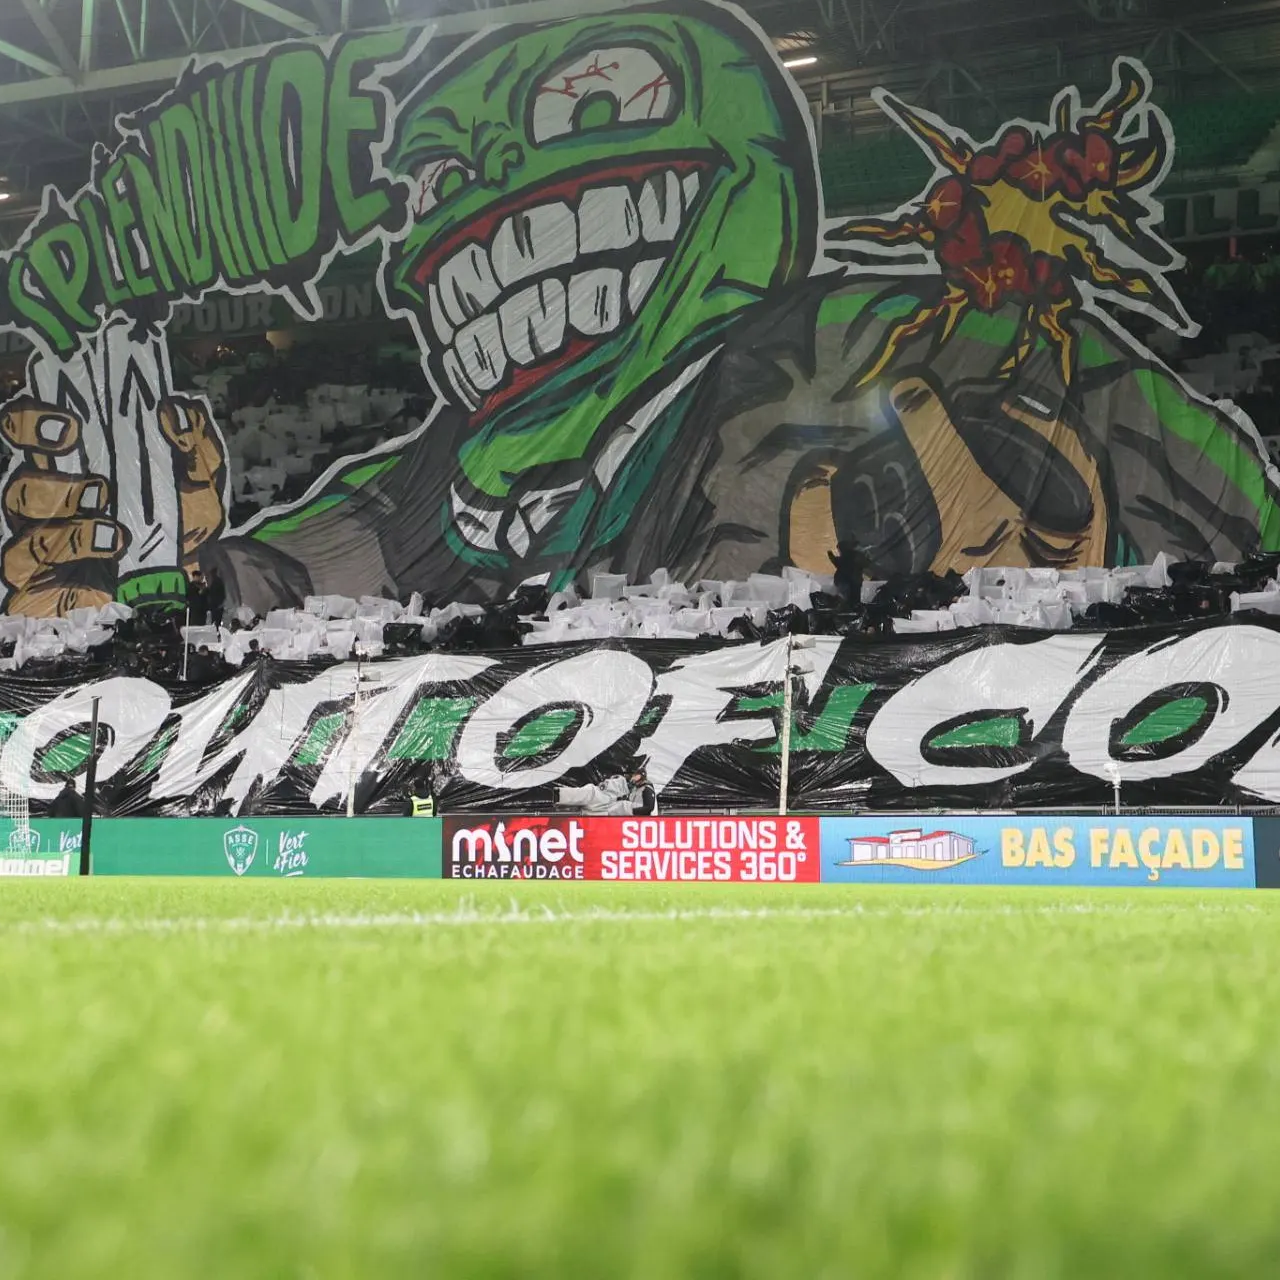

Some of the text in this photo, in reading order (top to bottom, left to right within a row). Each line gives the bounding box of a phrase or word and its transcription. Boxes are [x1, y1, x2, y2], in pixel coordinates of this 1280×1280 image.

[297, 282, 374, 324] ON
[227, 833, 255, 845] ASSE
[279, 829, 311, 853] Vert
[623, 820, 807, 850] SOLUTIONS &
[601, 851, 807, 882] SERVICES 360°
[1000, 826, 1245, 881] BAS FAÇADE
[452, 865, 584, 879] ECHAFAUDAGE
